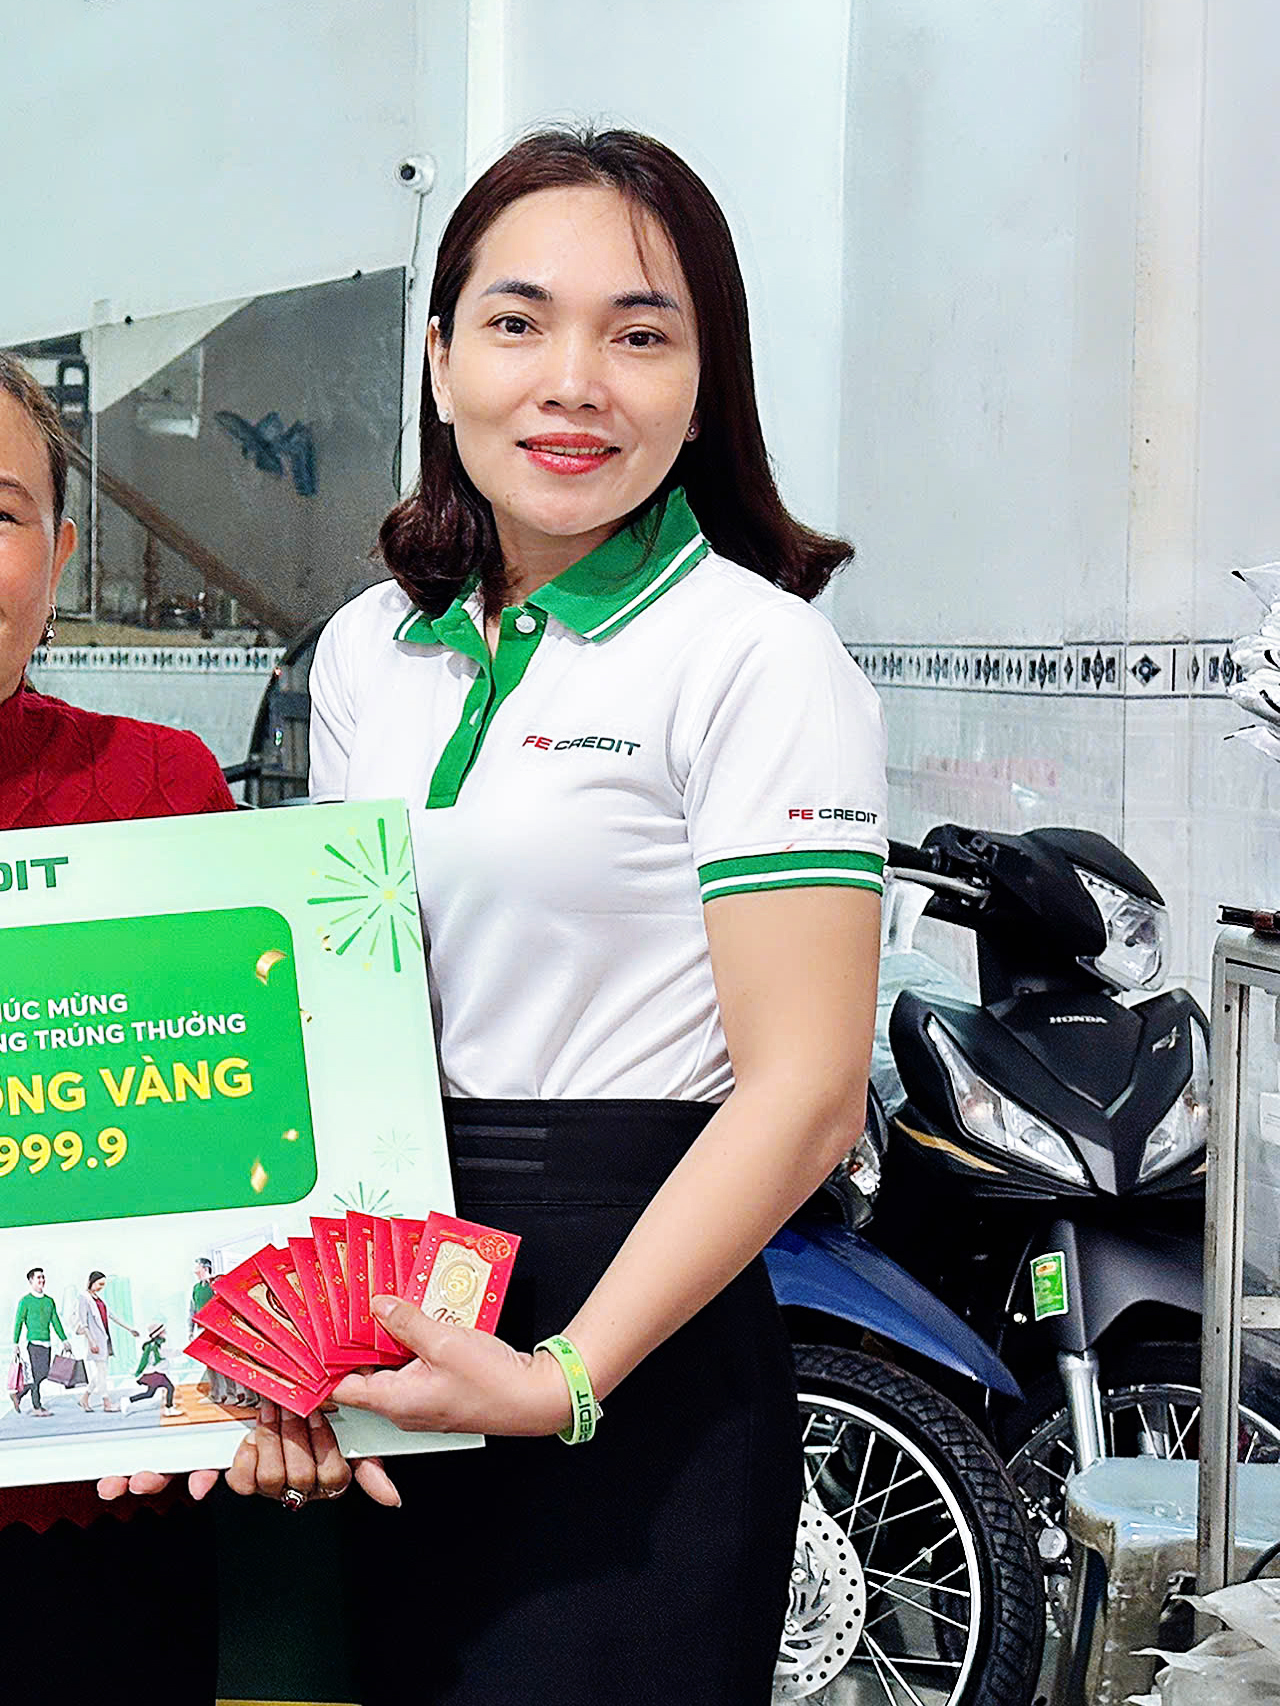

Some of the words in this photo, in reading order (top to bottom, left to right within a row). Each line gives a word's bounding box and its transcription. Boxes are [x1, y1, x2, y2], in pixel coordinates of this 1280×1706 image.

[522, 735, 553, 751] FE
[554, 736, 641, 756] CREDIT
[788, 808, 814, 820] FE
[818, 808, 878, 824] CREDIT
[47, 992, 129, 1020] MỪNG
[33, 1022, 125, 1050] TRÚNG
[98, 1055, 254, 1107] VÀNG
[576, 1390, 592, 1441] REDIT
